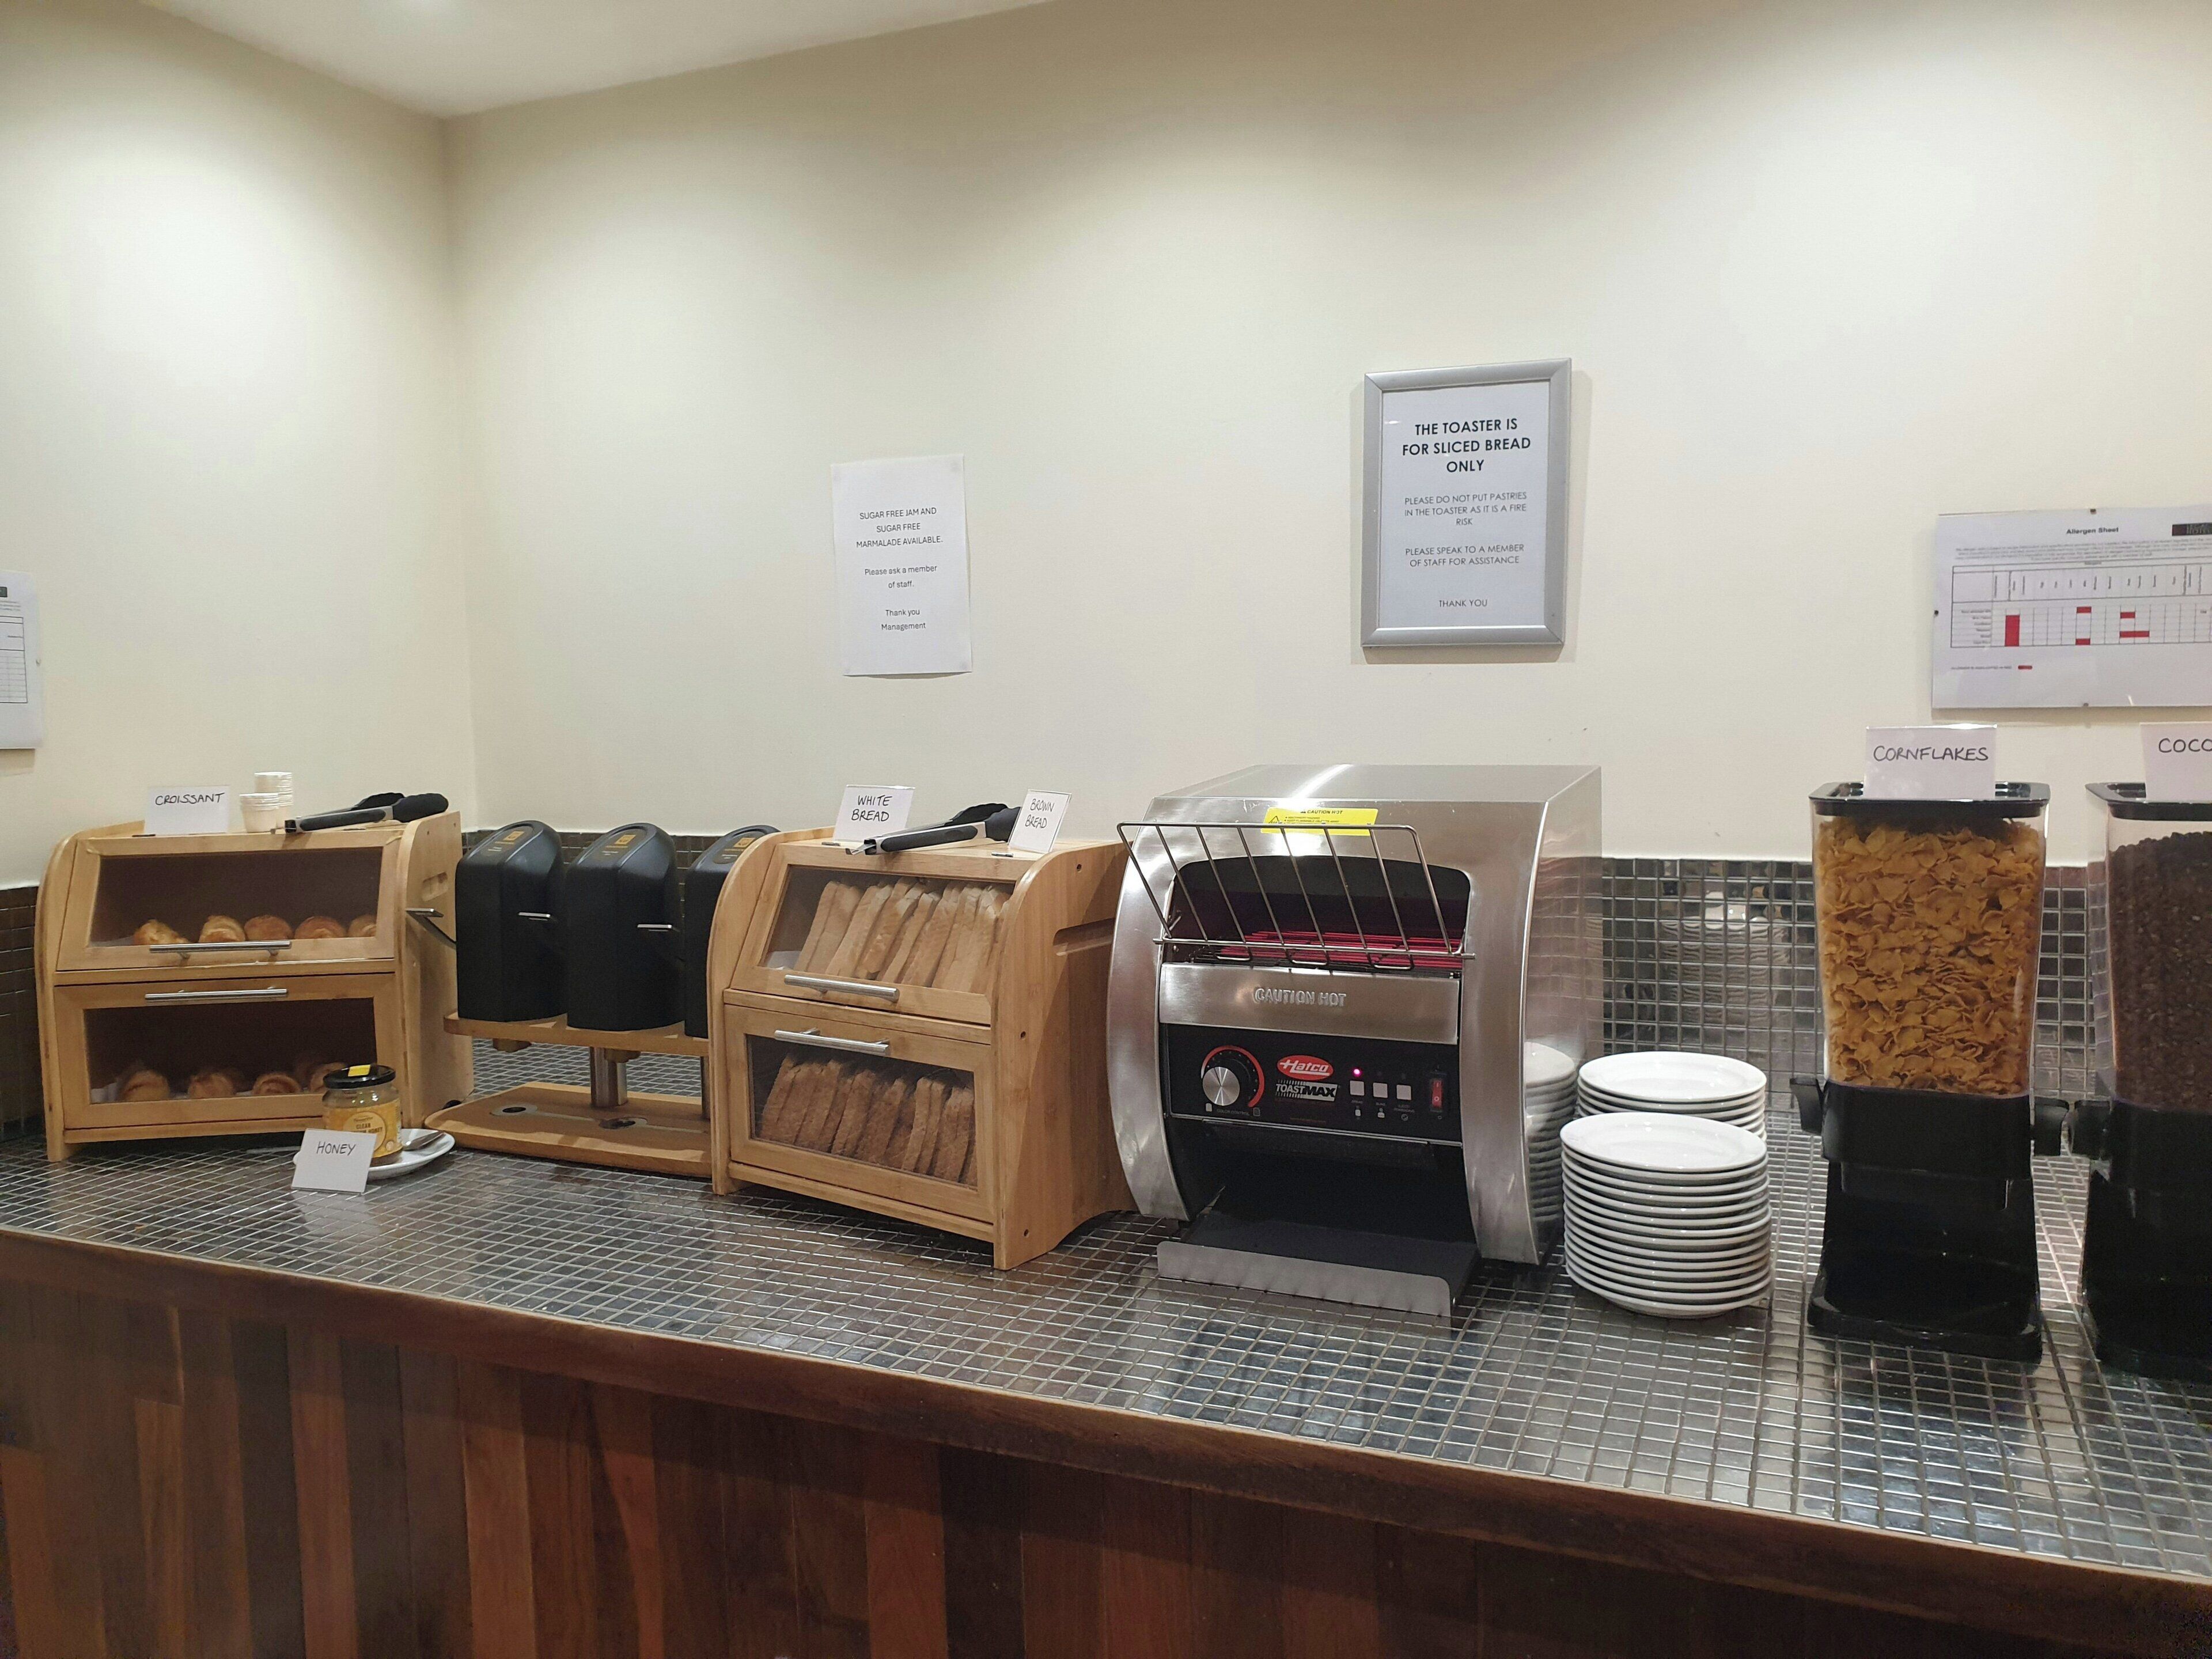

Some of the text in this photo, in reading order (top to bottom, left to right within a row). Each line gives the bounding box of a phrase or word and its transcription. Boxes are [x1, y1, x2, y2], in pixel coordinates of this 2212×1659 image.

[1415, 418, 1517, 435] THE TOASTER IS
[1403, 437, 1531, 456] FOR SLICED BREAD
[1446, 460, 1484, 472] ONLY
[1405, 497, 1434, 505] PLEASE
[1436, 495, 1450, 503] DO
[1452, 494, 1470, 502] NOT
[1490, 492, 1527, 501] PASTRIES
[859, 507, 937, 520] SUGAR FREE JAM AND
[1415, 508, 1430, 516] THE
[1433, 506, 1467, 515] TOASTER
[1501, 504, 1508, 512] A
[1510, 503, 1527, 512] FIRE
[876, 524, 901, 533] SUGAR
[2066, 527, 2096, 535] Allergen
[856, 536, 943, 548] MARMALADE AVAILABLE.
[1406, 544, 1524, 556] PLEASE SPEAK TO A MEMBER
[1410, 556, 1519, 567] OF STAFF FOR ASSISTANCE
[865, 567, 887, 576] Please
[889, 567, 901, 575] ask
[908, 565, 937, 573] member
[888, 581, 895, 589] of
[1439, 599, 1487, 608] THANK YOU
[886, 608, 920, 617] Thank you
[881, 622, 926, 631] Management
[2158, 738, 2212, 753] COCO
[1873, 745, 1988, 762] CORNFLAKES
[155, 792, 225, 806] CROISSANT
[857, 794, 893, 806] WHITE
[1029, 798, 1055, 813] BROWN
[851, 809, 890, 822] BREAD
[1025, 813, 1047, 829] BREAD
[1253, 987, 1346, 1007] CAUTION HOT
[1279, 1059, 1330, 1076] Hatco
[316, 1141, 356, 1156] HONEY
